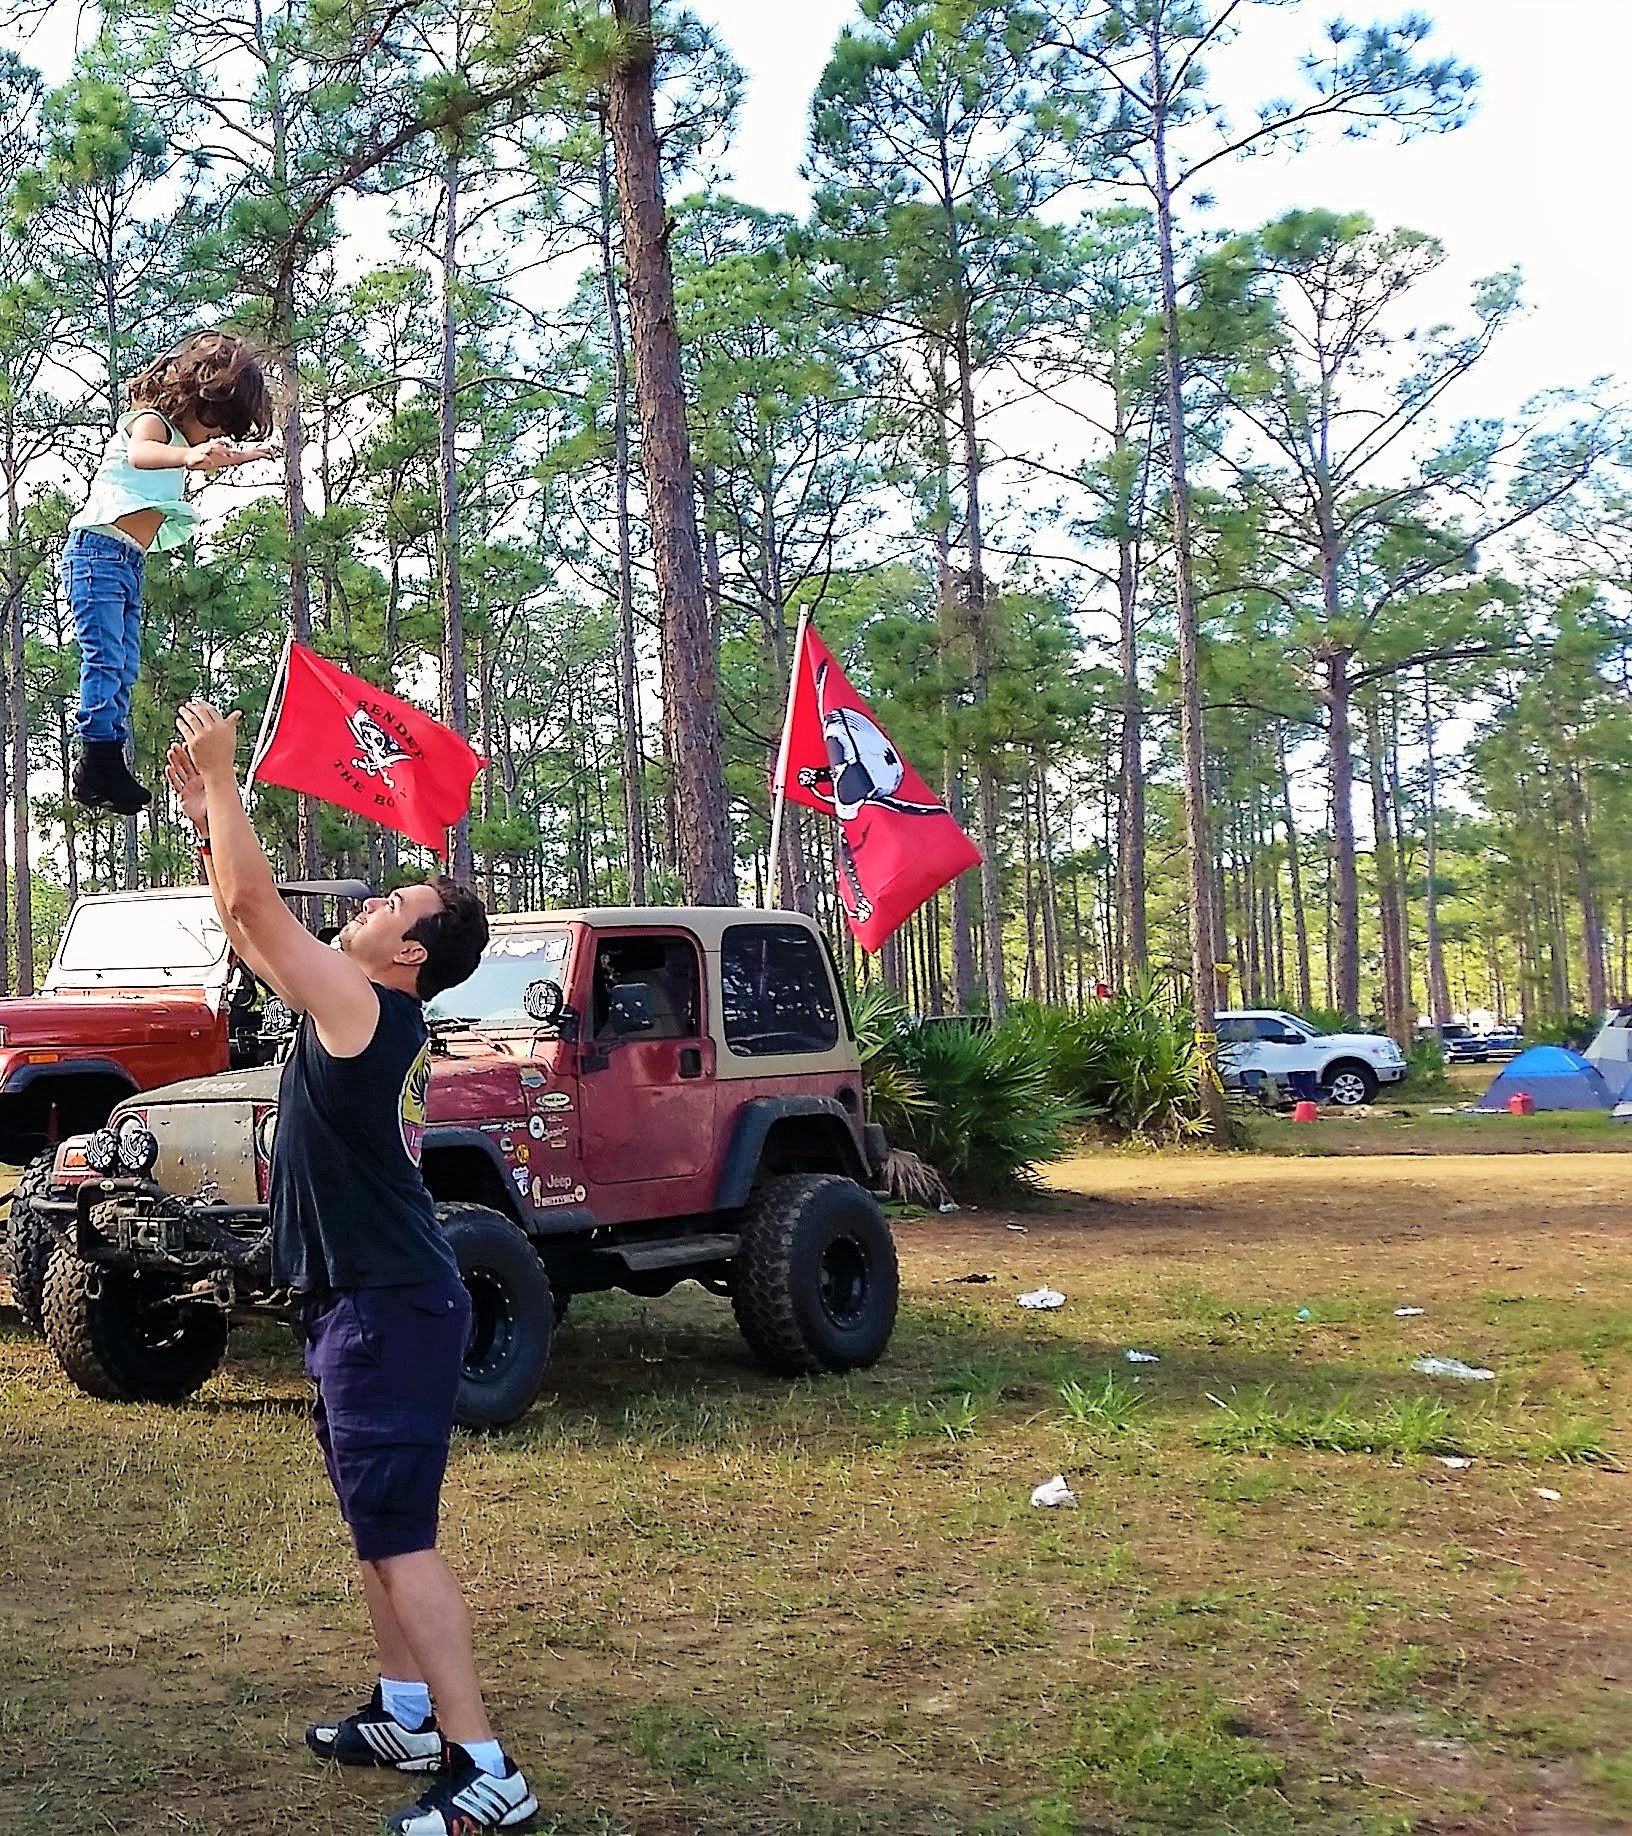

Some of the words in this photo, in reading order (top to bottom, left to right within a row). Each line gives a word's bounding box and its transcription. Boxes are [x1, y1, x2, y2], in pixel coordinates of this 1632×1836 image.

[333, 758, 366, 793] THE
[181, 1081, 249, 1095] Jeep
[546, 1174, 572, 1190] Jeep
